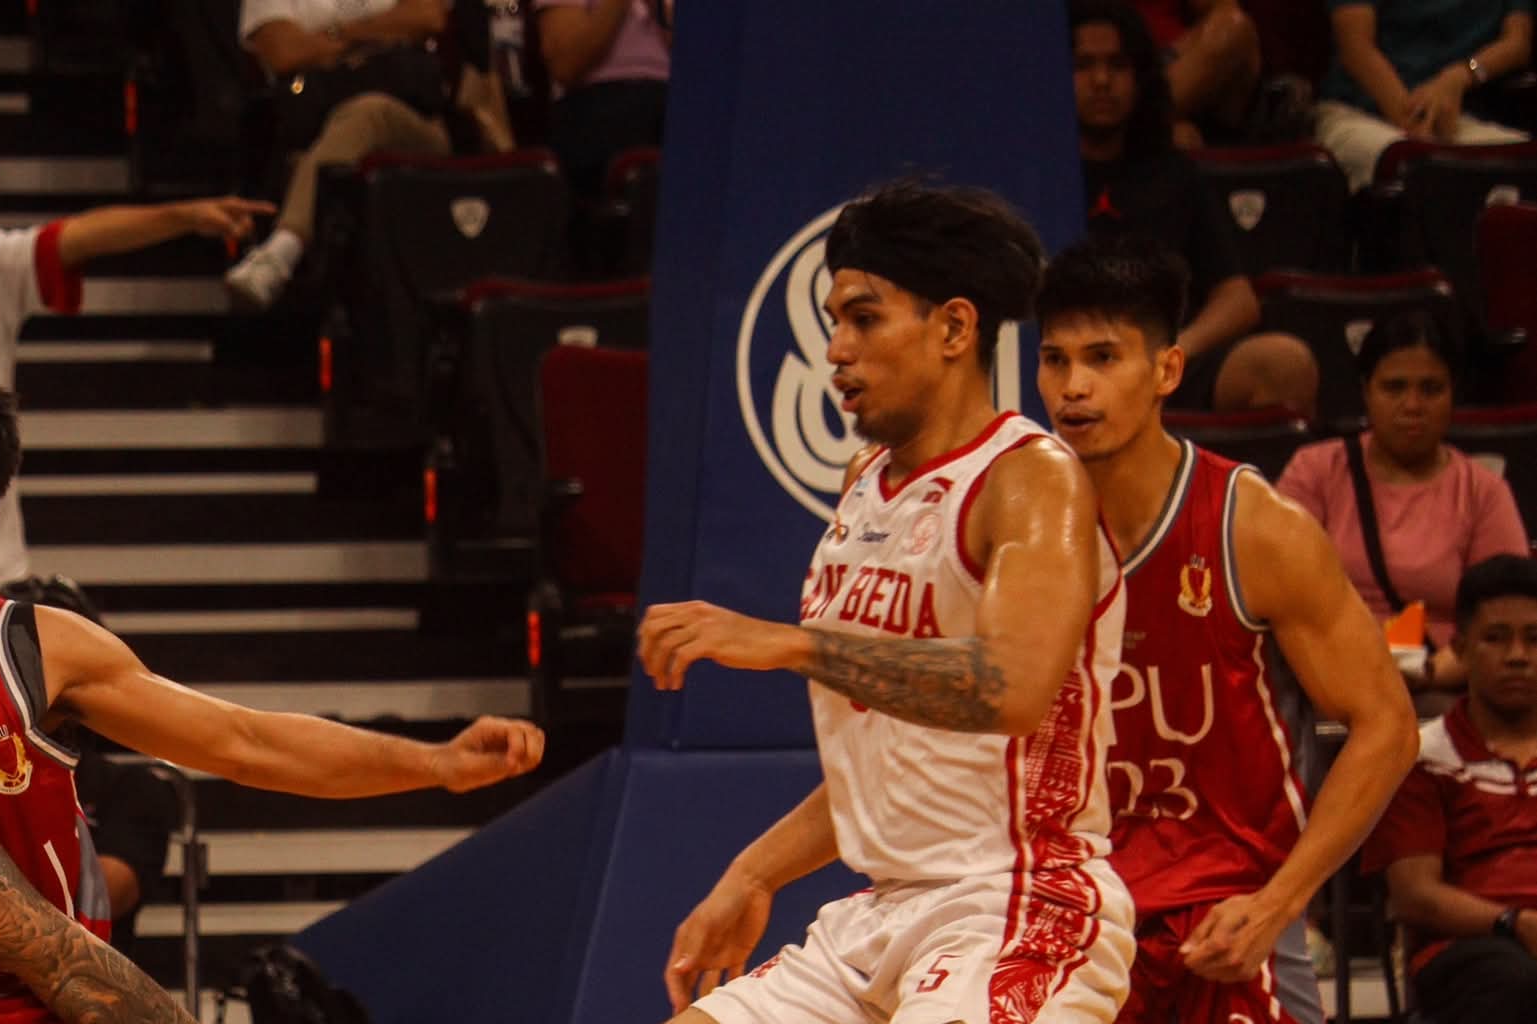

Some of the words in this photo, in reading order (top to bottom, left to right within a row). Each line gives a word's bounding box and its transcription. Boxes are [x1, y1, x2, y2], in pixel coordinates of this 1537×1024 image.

[840, 565, 945, 638] BEDA
[1111, 662, 1215, 745] PU
[916, 954, 960, 993] 5
